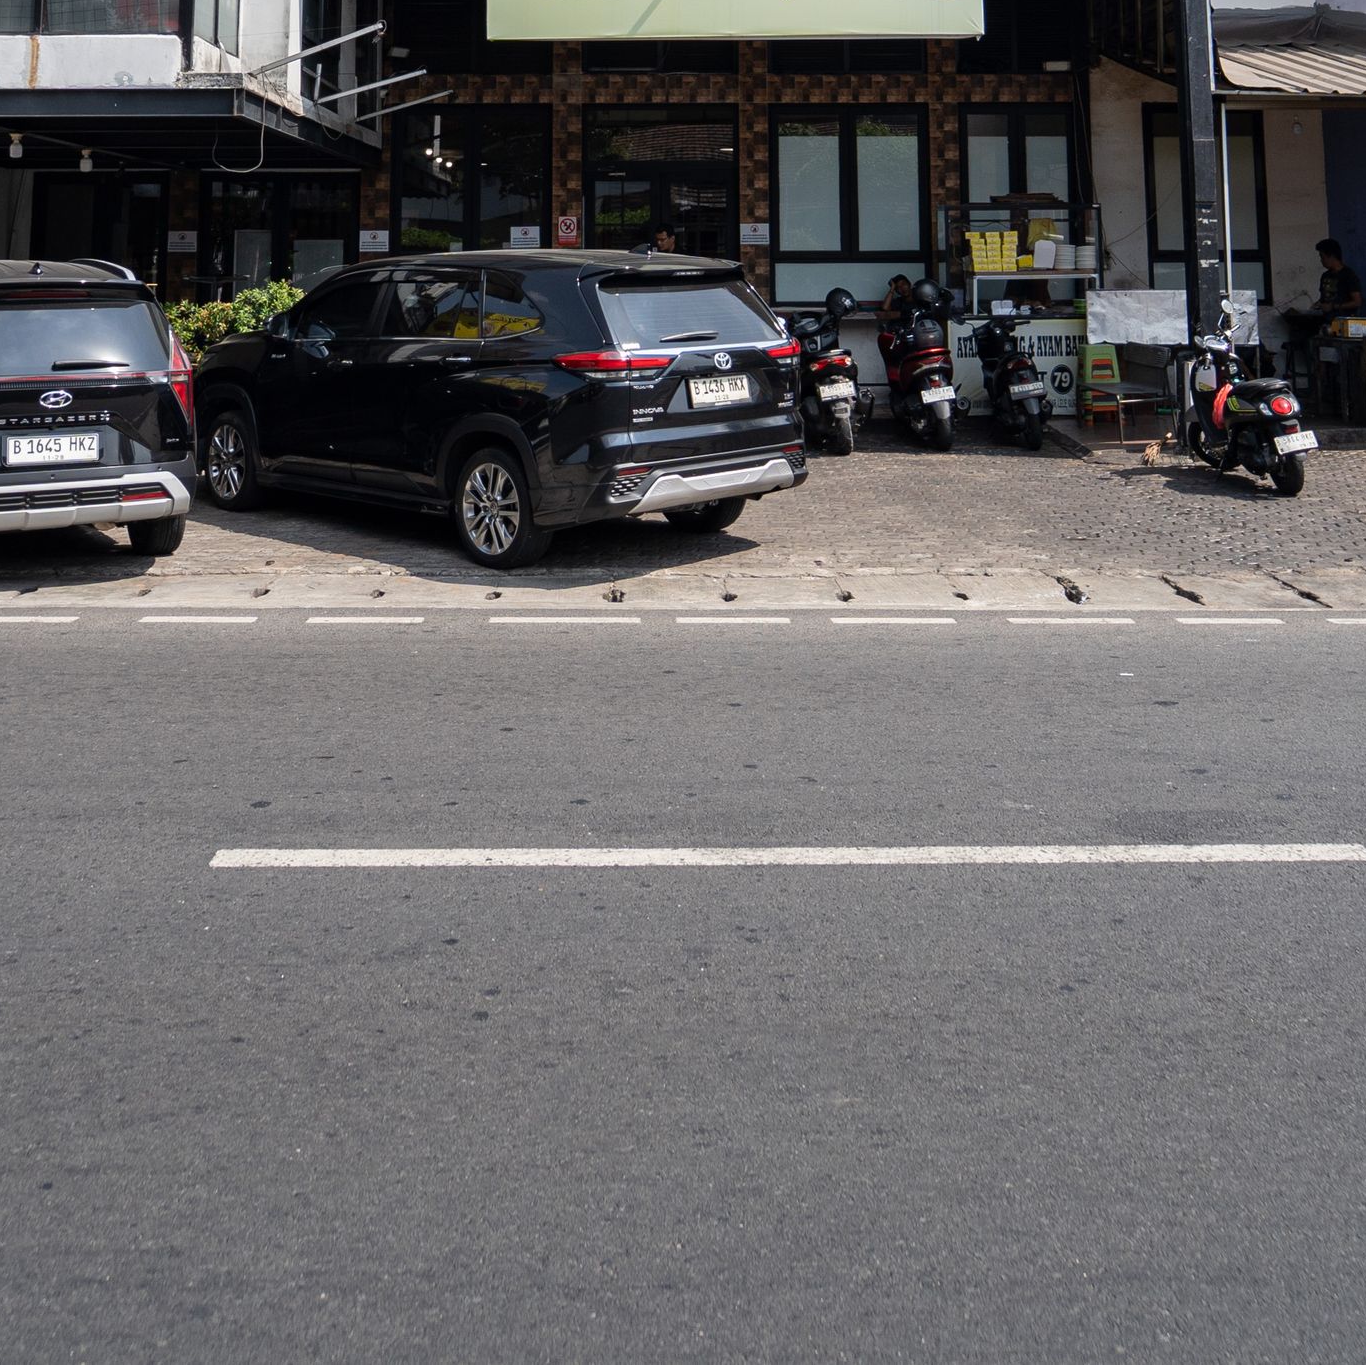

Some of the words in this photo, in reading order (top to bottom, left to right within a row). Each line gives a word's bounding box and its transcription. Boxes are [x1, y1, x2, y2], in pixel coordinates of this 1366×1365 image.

[957, 336, 978, 358] AYA
[1036, 335, 1063, 356] AYAM
[1064, 335, 1087, 356] BA
[693, 381, 701, 395] B
[704, 380, 725, 394] 1436
[729, 377, 746, 391] HKX
[1054, 371, 1070, 387] 79
[13, 440, 22, 454] B
[27, 438, 62, 454] 1645
[69, 436, 96, 451] HKZ
